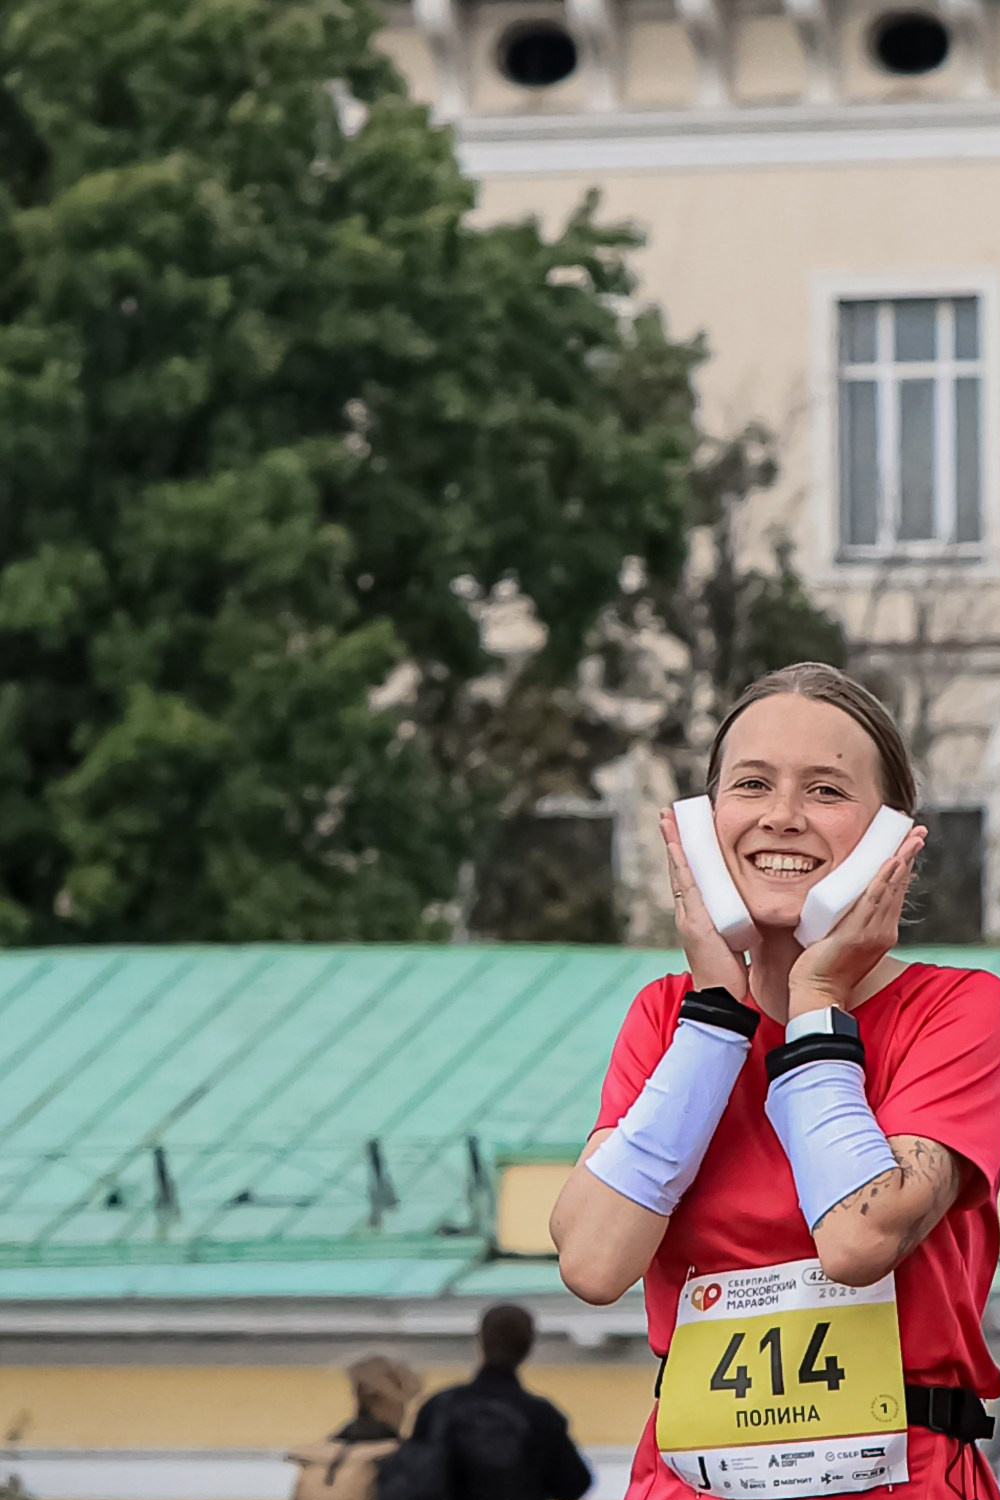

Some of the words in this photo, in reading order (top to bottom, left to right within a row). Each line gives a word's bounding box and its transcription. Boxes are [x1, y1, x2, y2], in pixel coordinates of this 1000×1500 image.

[727, 1279, 797, 1299] МОСКОВСКИЙ
[728, 1273, 780, 1288] СБЕРПРАЙМ
[726, 1294, 779, 1311] МАРАФОН
[710, 1322, 846, 1399] 414
[736, 1404, 821, 1428] ПОЛИНА
[880, 1403, 888, 1414] 1
